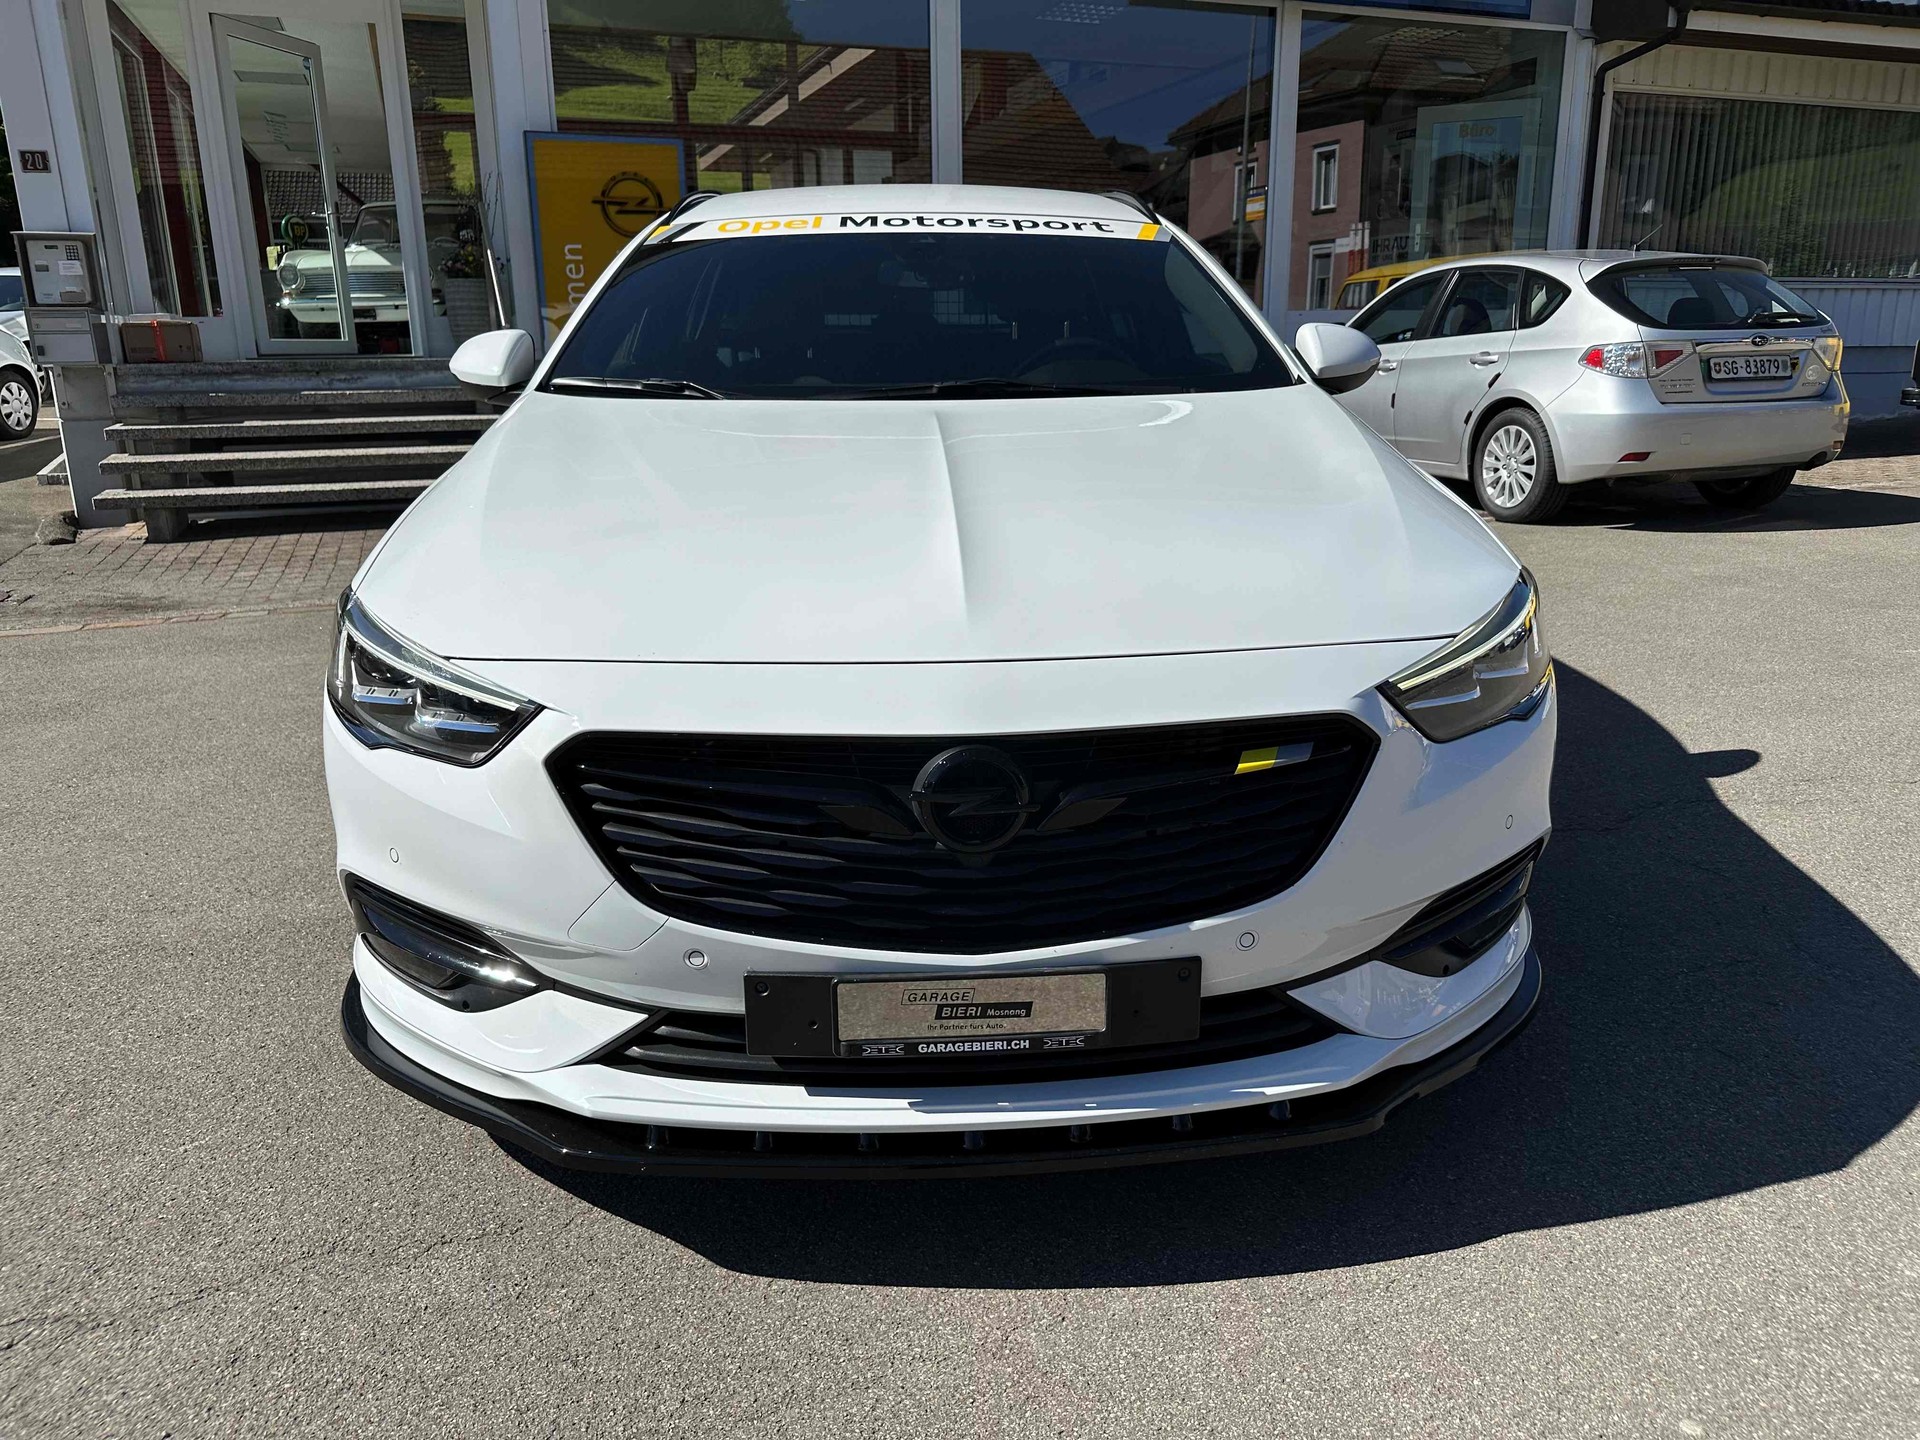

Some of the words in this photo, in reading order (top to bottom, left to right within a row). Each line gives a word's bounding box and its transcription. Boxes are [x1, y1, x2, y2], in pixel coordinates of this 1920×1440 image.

[25, 153, 43, 170] 20
[294, 225, 305, 236] BP
[717, 216, 823, 234] Opel
[839, 215, 1115, 235] Motorsport
[1372, 238, 1390, 253] IHR
[907, 991, 970, 1003] GARAGE
[941, 1006, 981, 1017] BIERI
[986, 1008, 1027, 1017] Mosnang
[940, 1023, 968, 1031] Partner
[918, 1040, 1030, 1053] GARAGEBIERI.CH
